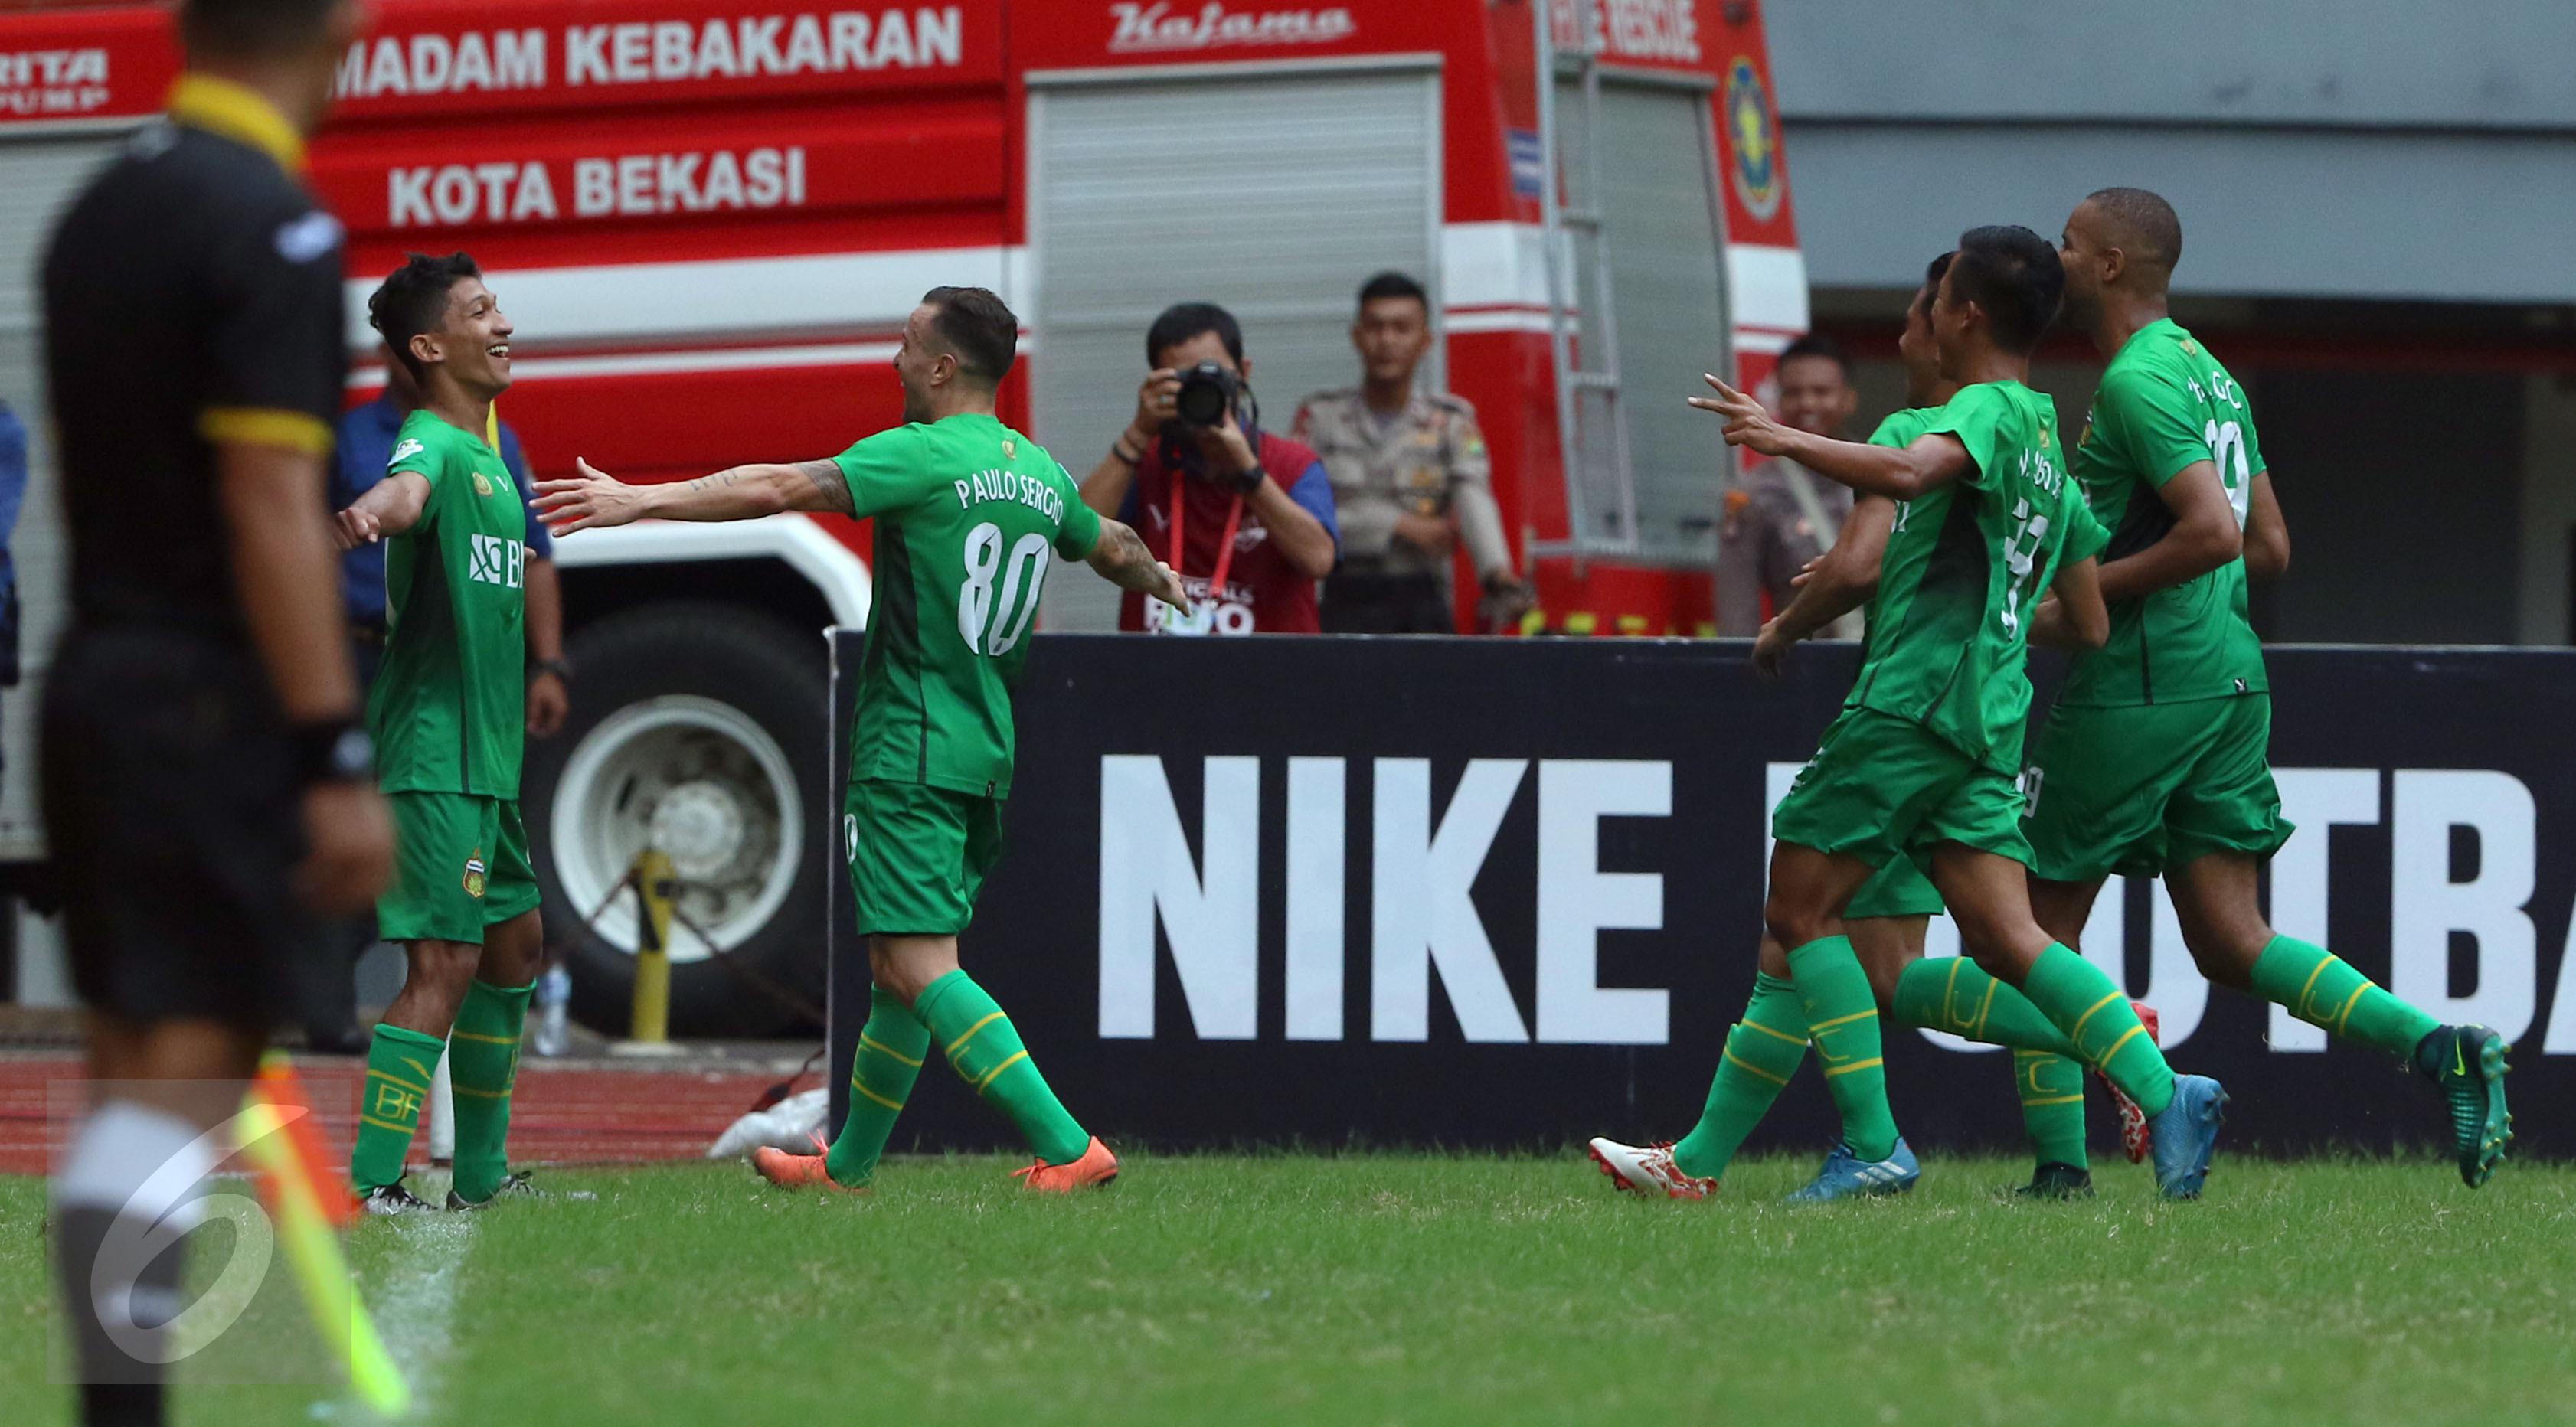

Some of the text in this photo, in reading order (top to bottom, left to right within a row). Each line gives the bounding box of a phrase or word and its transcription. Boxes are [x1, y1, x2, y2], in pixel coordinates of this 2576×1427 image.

[565, 7, 962, 86] KEBAKARAN
[387, 146, 807, 227] KOTA BEKASI
[954, 469, 1064, 526] PAULO SERGIO
[958, 522, 1050, 657] 80
[1098, 754, 1672, 1045] NIKE
